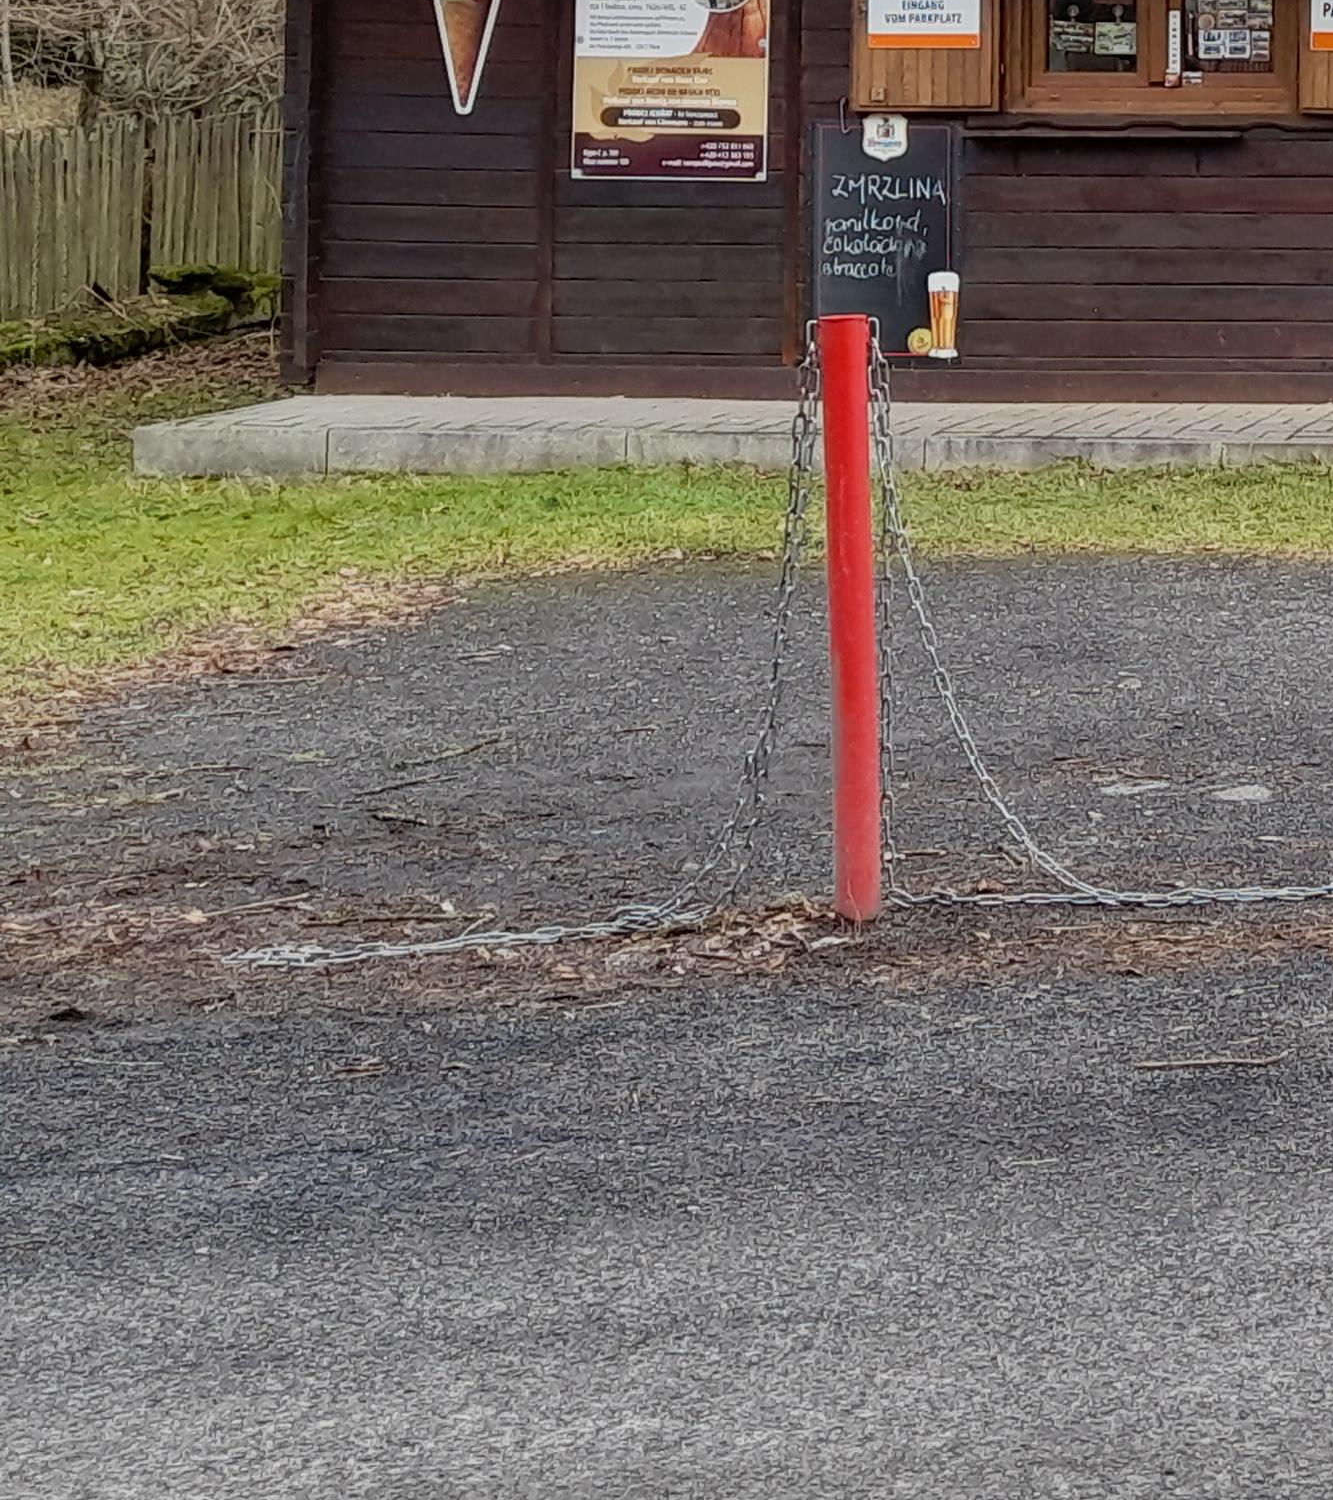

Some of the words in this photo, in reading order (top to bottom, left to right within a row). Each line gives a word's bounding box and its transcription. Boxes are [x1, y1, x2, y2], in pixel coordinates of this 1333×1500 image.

[902, 0, 944, 10] EINGANG
[885, 13, 905, 23] VOM
[908, 13, 962, 23] PARKPLATZ
[832, 174, 947, 205] ZMRZLINA
